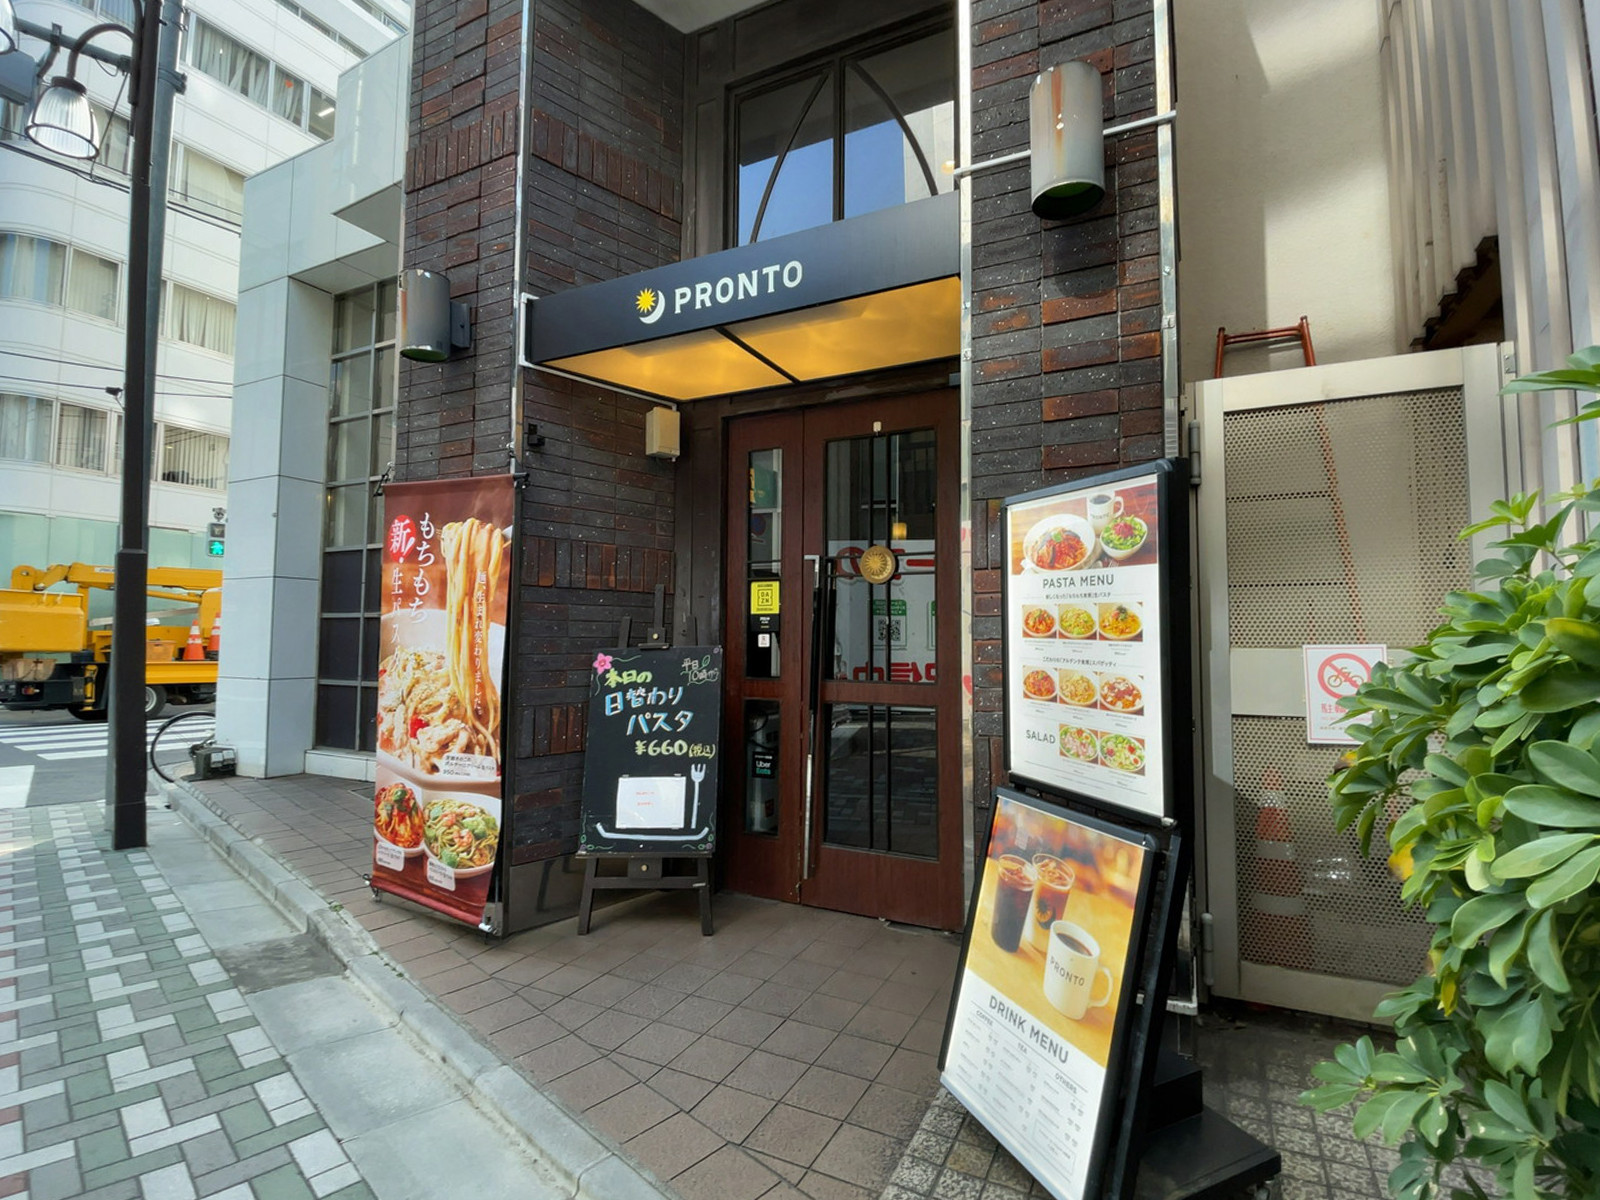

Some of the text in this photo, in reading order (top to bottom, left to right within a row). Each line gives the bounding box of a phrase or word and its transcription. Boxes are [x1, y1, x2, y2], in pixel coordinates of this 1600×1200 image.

[674, 260, 803, 314] PRONTO
[409, 512, 435, 624] もちもち
[1042, 574, 1114, 589] PASTA MENU
[604, 668, 653, 688] 本日の
[605, 686, 683, 716] 日替わり
[626, 710, 694, 736] パスタ
[1026, 729, 1056, 744] SALAD
[755, 760, 771, 768] Uber
[1050, 956, 1084, 986] PRONTO
[988, 995, 1027, 1034] DRINK
[1029, 1024, 1069, 1064] MENU
